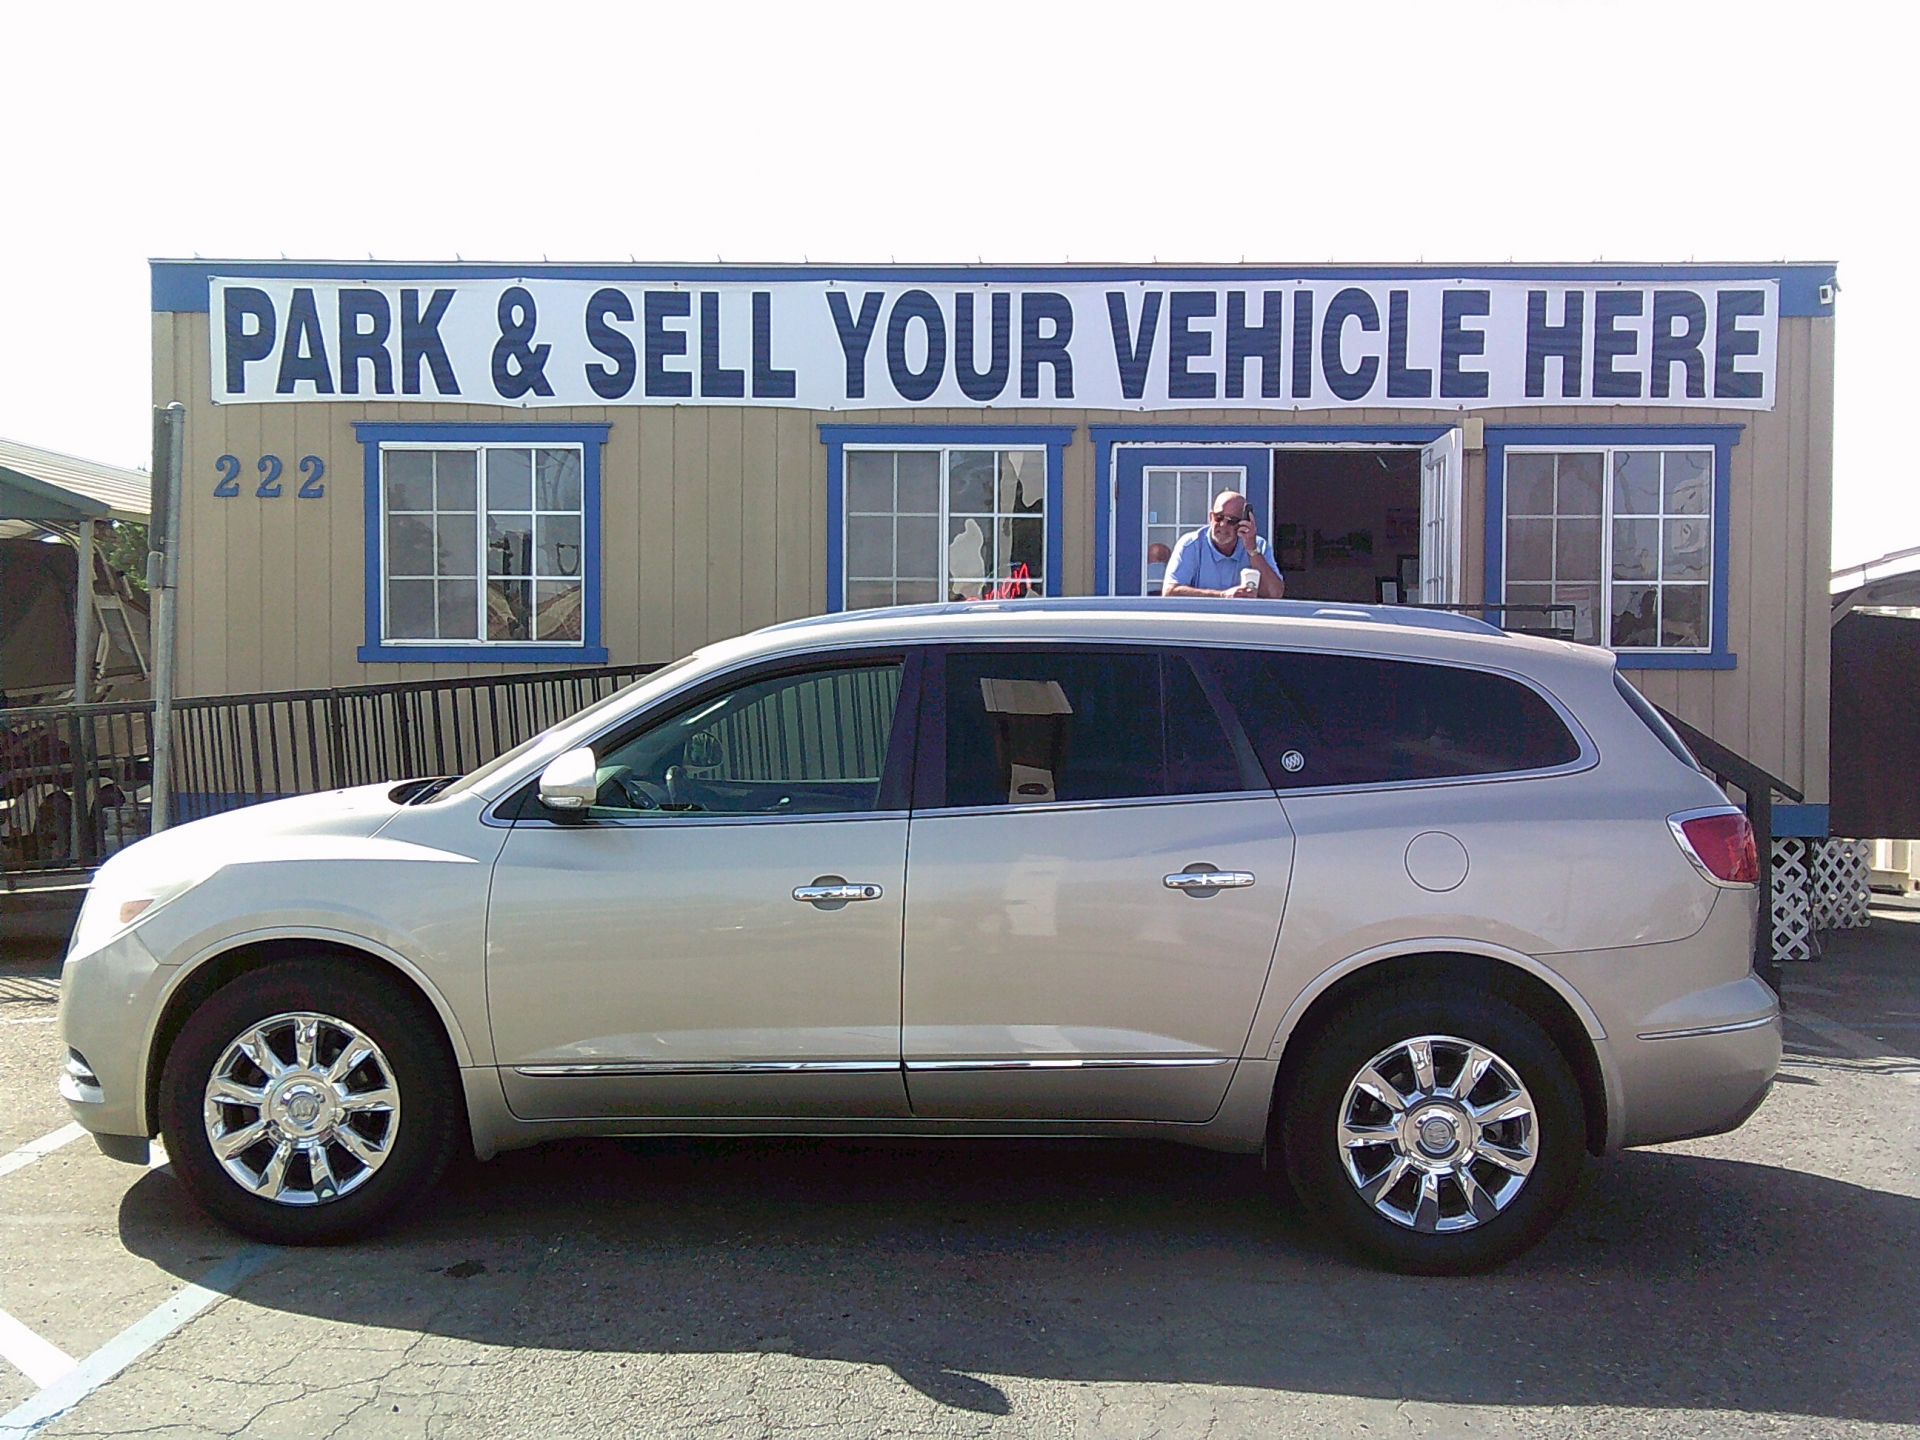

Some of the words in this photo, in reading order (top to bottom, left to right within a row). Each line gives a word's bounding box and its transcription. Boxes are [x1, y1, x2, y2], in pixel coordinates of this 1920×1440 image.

[224, 287, 462, 395] PARK
[491, 286, 556, 399] &
[585, 287, 796, 400] SELL
[826, 289, 1075, 402] YOUR
[1105, 287, 1491, 402] VEHICLE
[1524, 289, 1766, 399] HERE
[213, 454, 325, 498] 222
